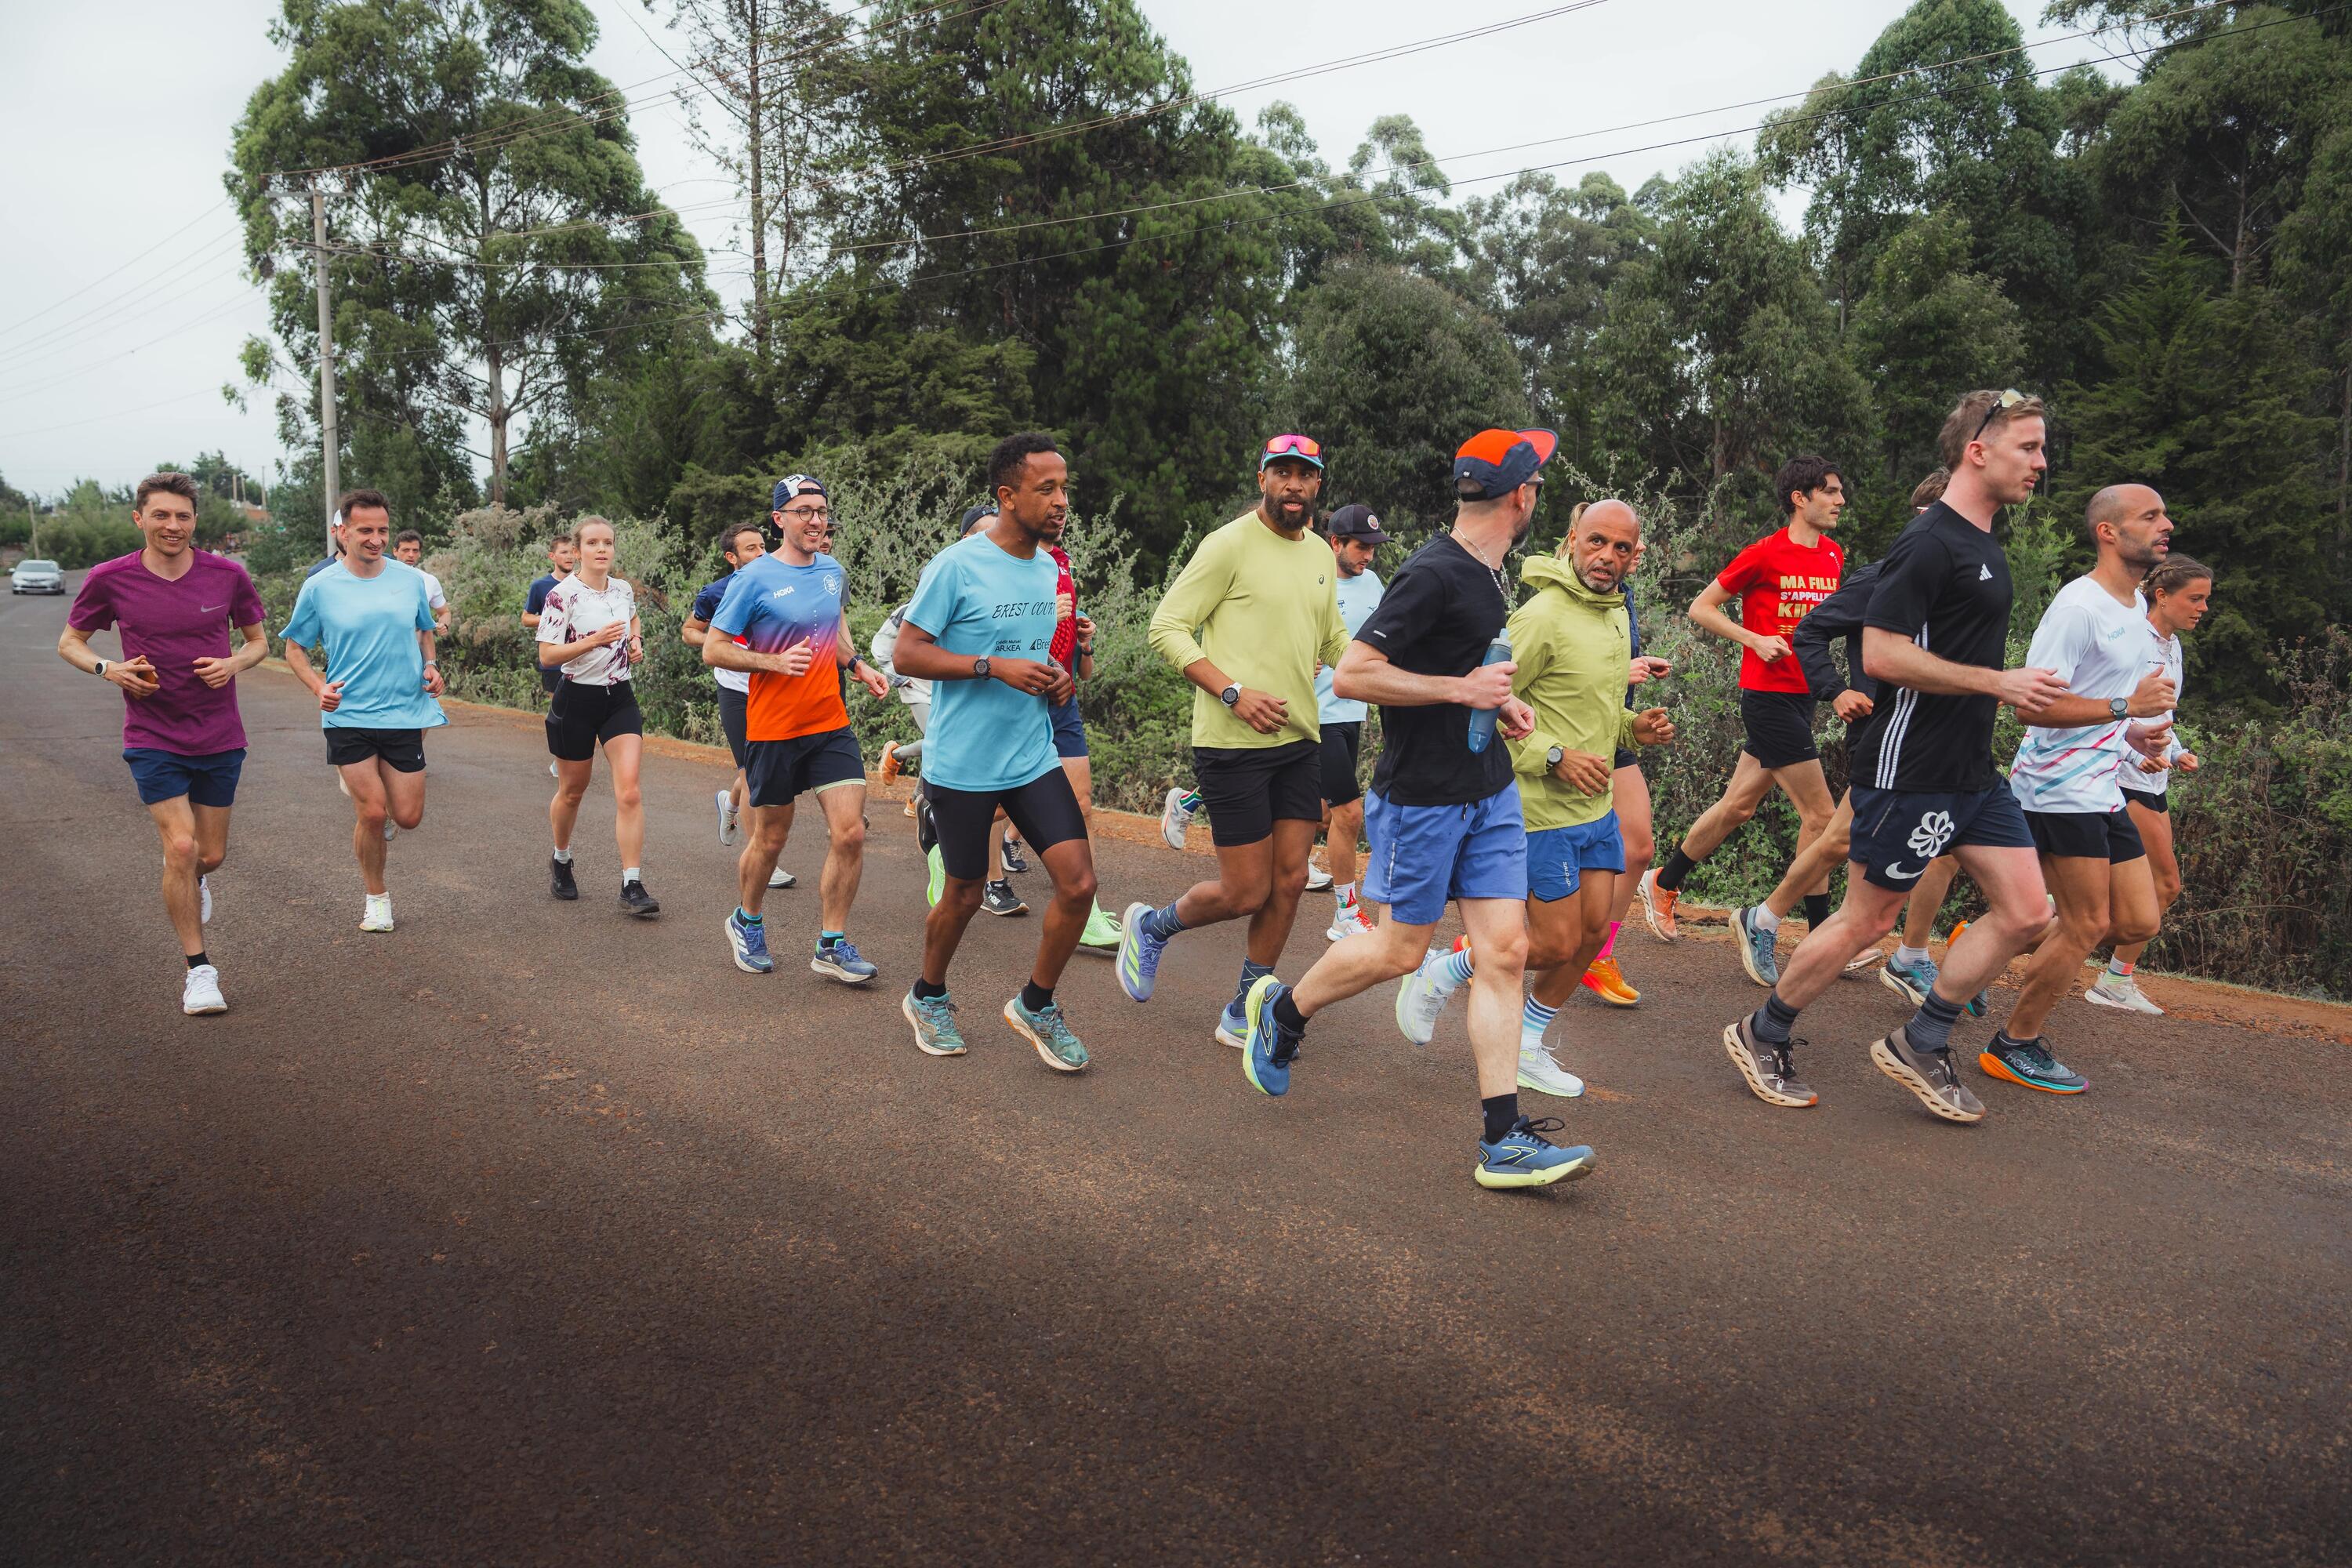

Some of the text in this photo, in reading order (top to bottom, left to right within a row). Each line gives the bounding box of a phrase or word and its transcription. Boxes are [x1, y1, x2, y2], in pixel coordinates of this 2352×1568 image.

[1780, 575, 1806, 590] MA
[773, 585, 795, 599] HOKA
[992, 602, 1029, 619] BREST
[2107, 627, 2125, 641] HOKA
[2005, 1053, 2035, 1077] HOKA
